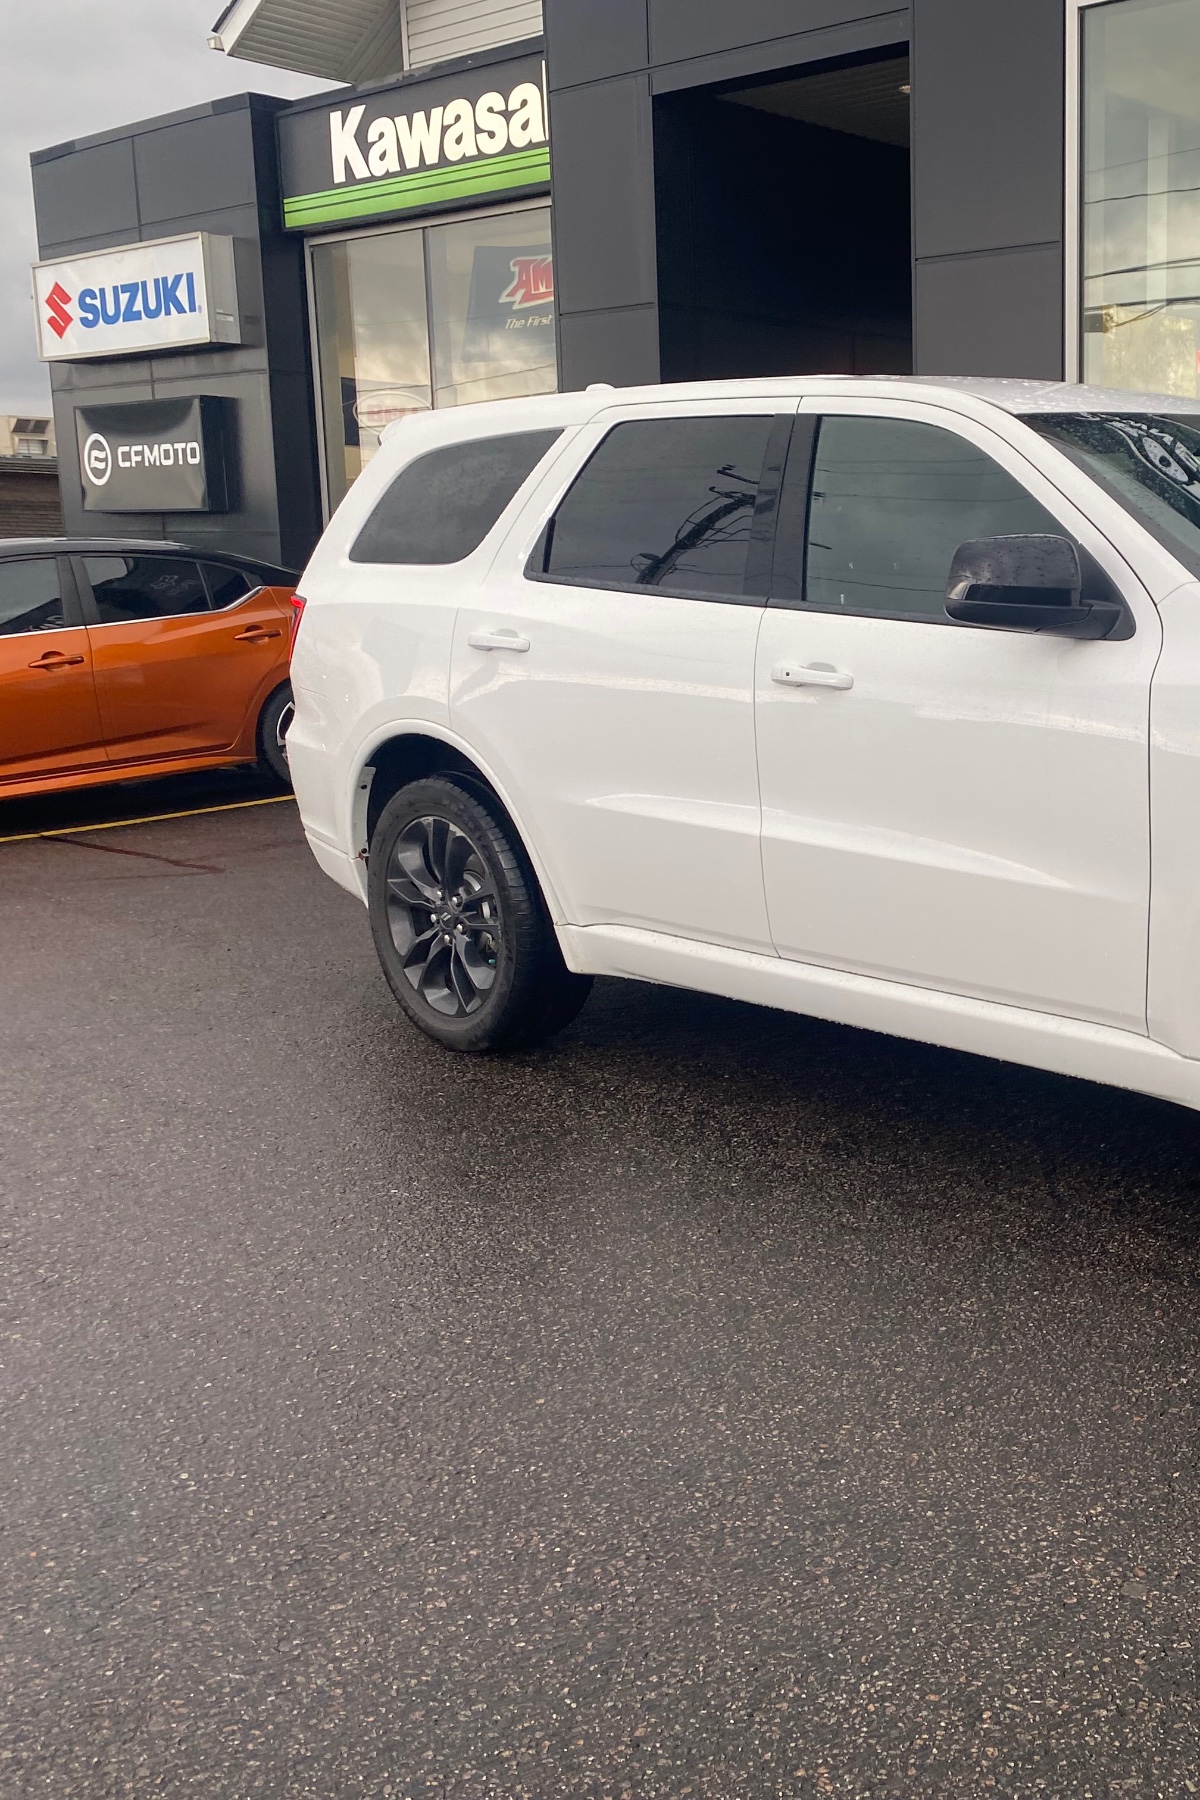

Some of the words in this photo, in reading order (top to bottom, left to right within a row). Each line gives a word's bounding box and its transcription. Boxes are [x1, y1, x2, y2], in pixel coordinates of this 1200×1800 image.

[329, 61, 549, 184] Kawasa
[78, 272, 197, 329] SUZUKI
[505, 318, 526, 330] The
[527, 314, 553, 328] First
[117, 441, 201, 468] CFMOTO
